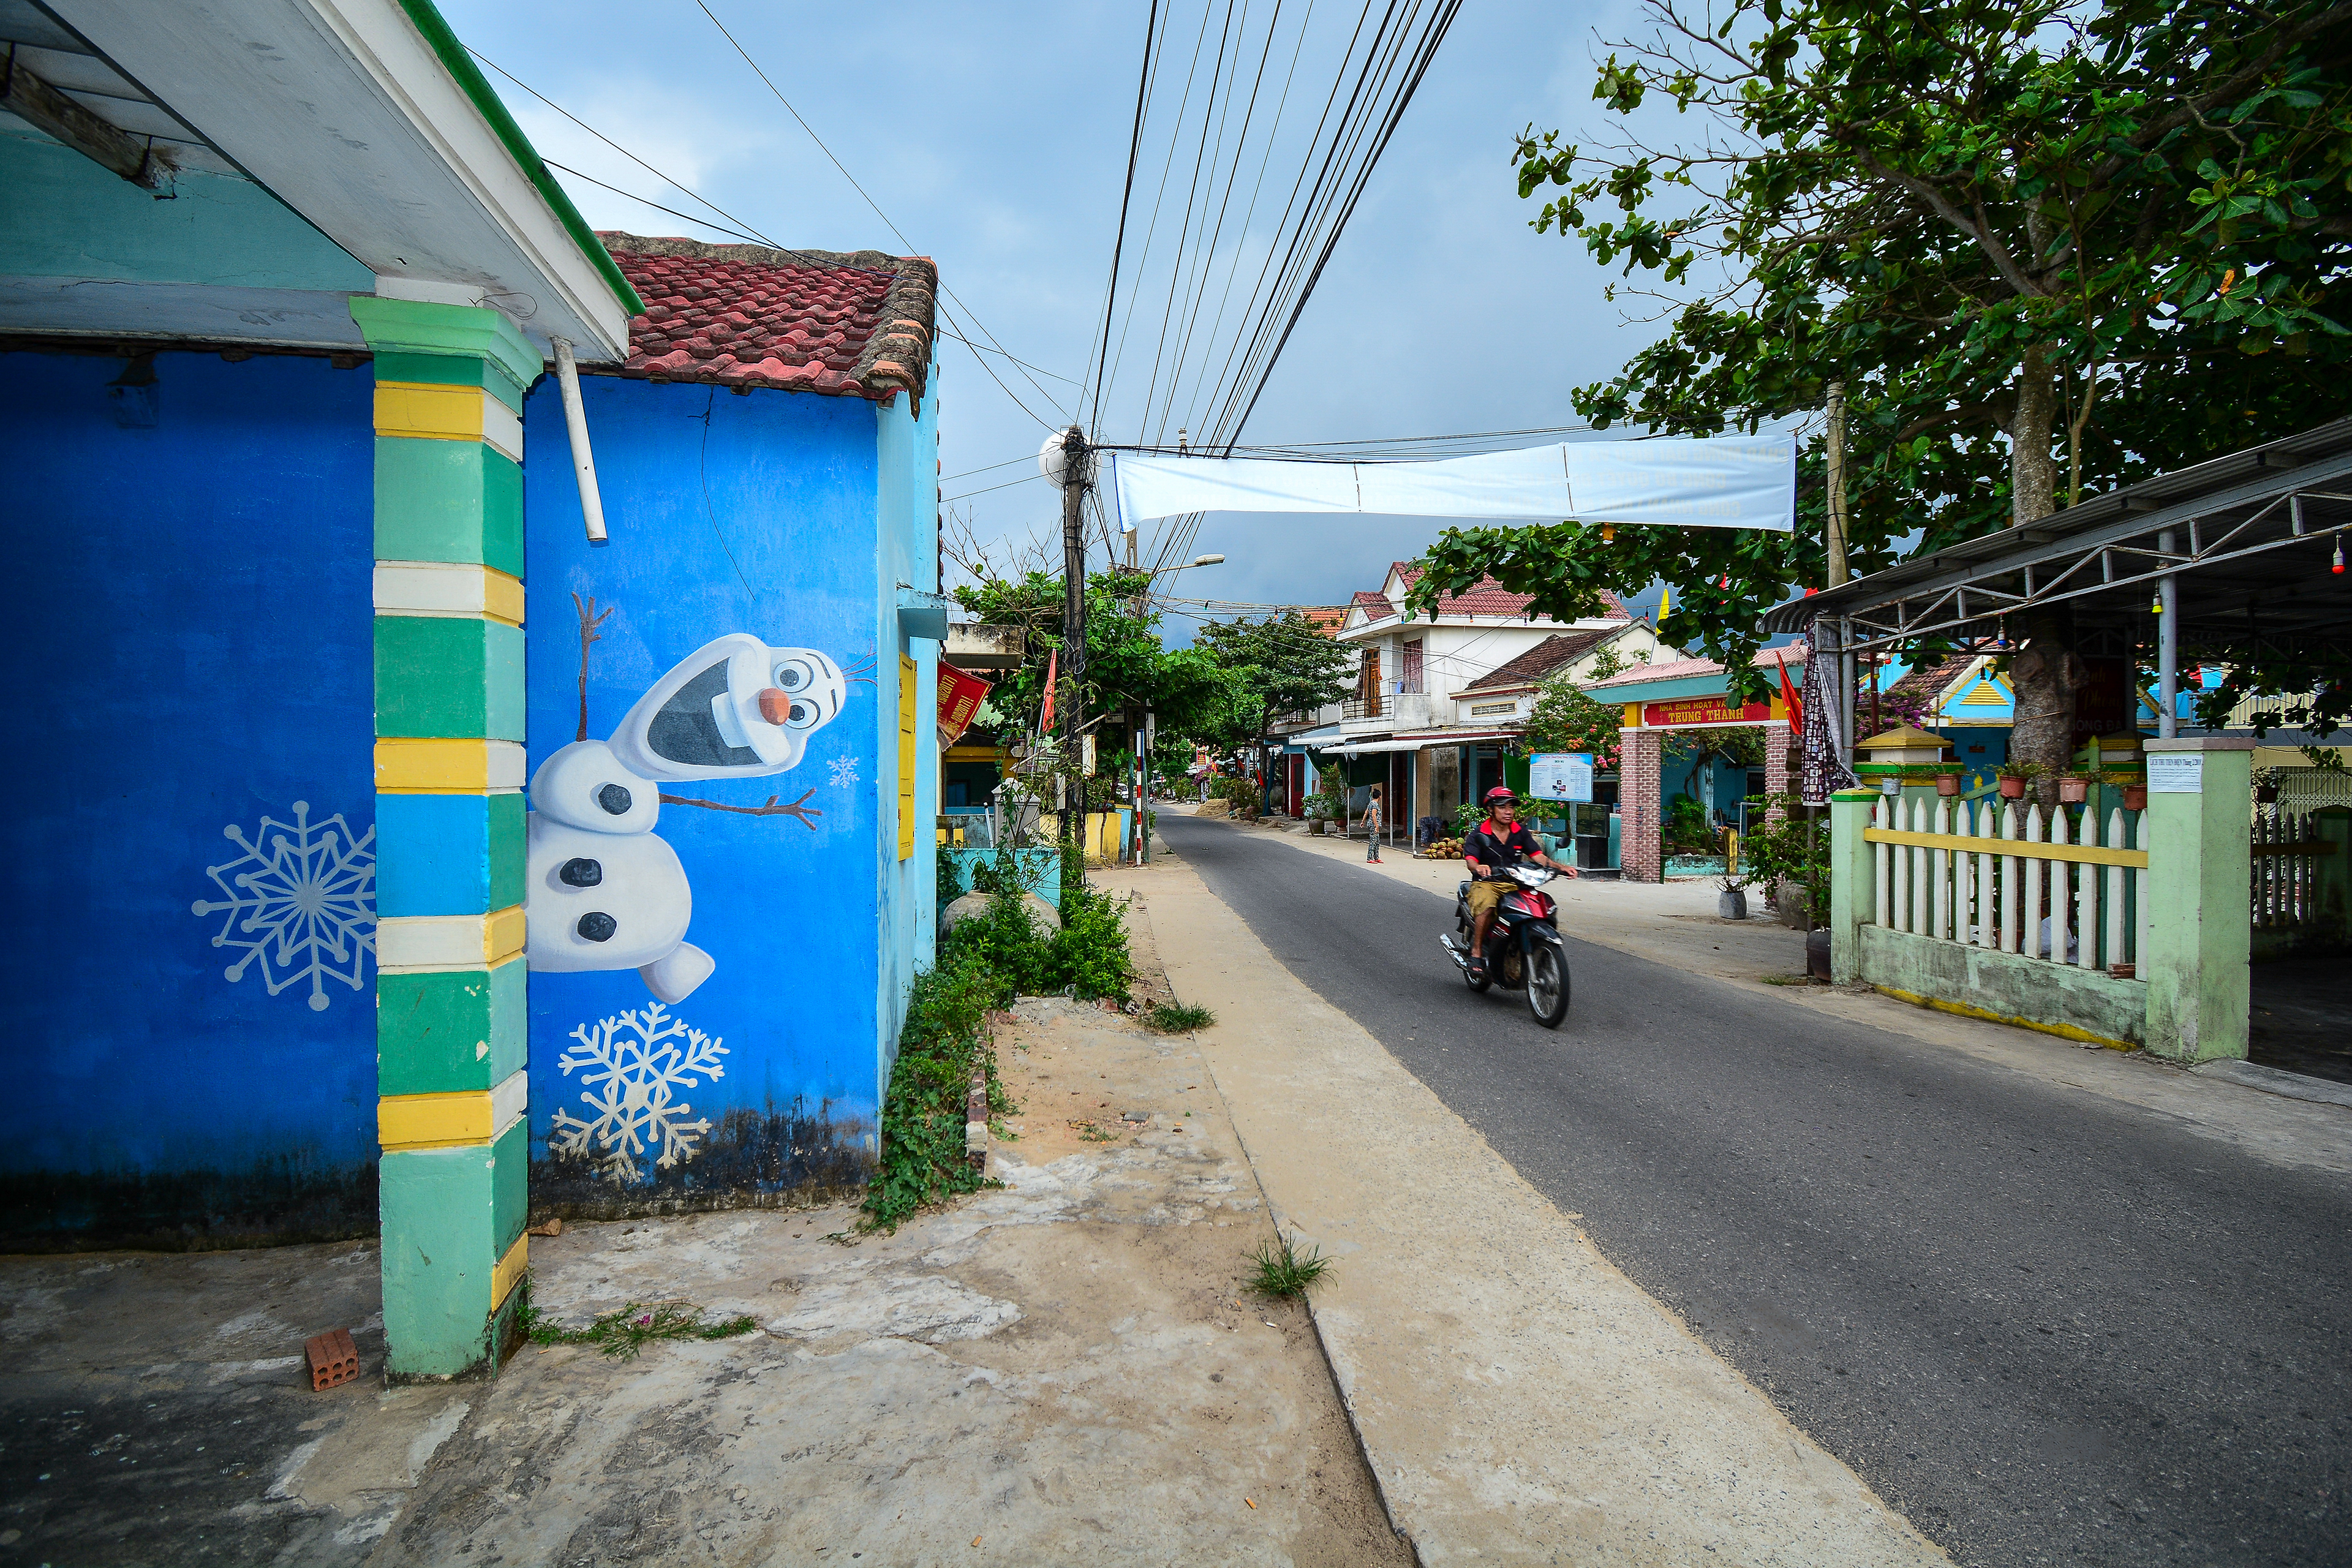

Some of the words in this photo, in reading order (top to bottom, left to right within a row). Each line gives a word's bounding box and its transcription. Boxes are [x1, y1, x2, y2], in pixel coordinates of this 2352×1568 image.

[1668, 711, 1702, 723] TRUNG
[1706, 708, 1744, 721] THANH
[2075, 716, 2103, 731] ÓNG
